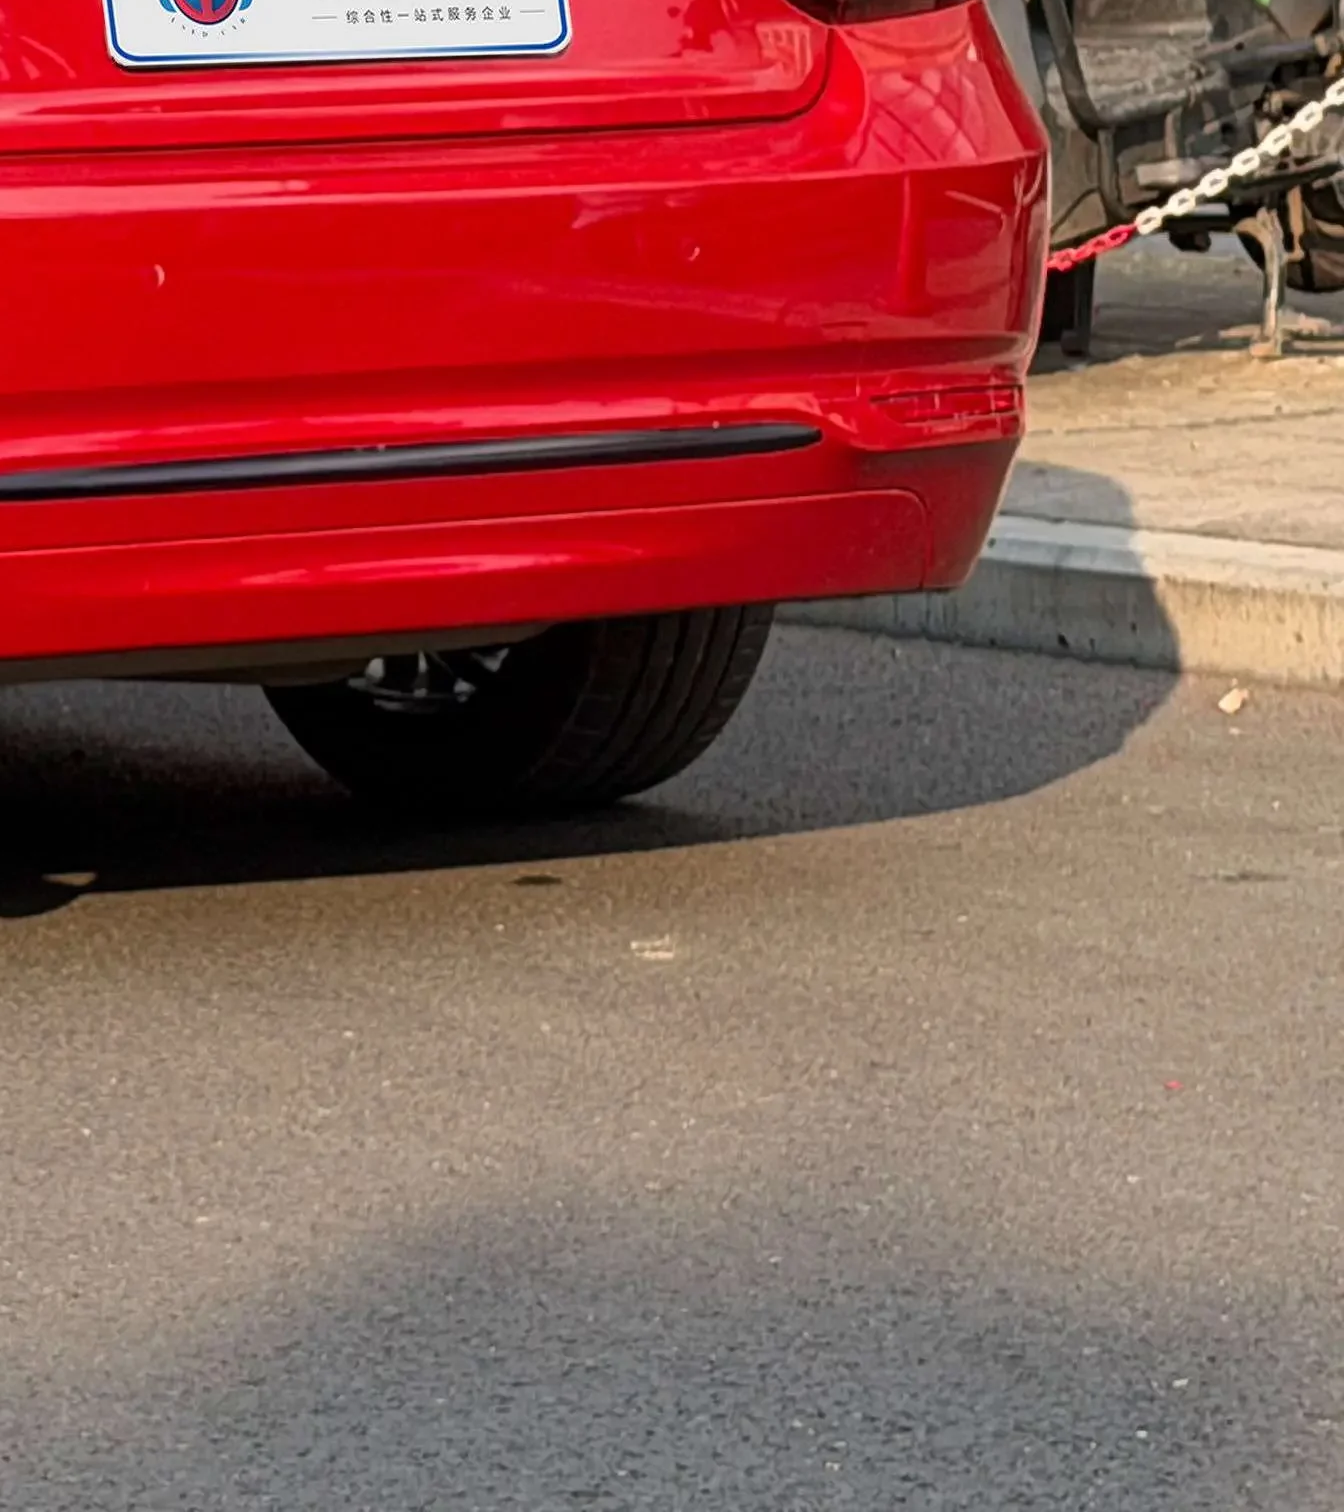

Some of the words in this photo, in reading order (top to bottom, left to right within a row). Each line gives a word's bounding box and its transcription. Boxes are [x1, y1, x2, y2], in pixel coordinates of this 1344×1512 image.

[345, 5, 512, 25] 综合性一站式服务企业
